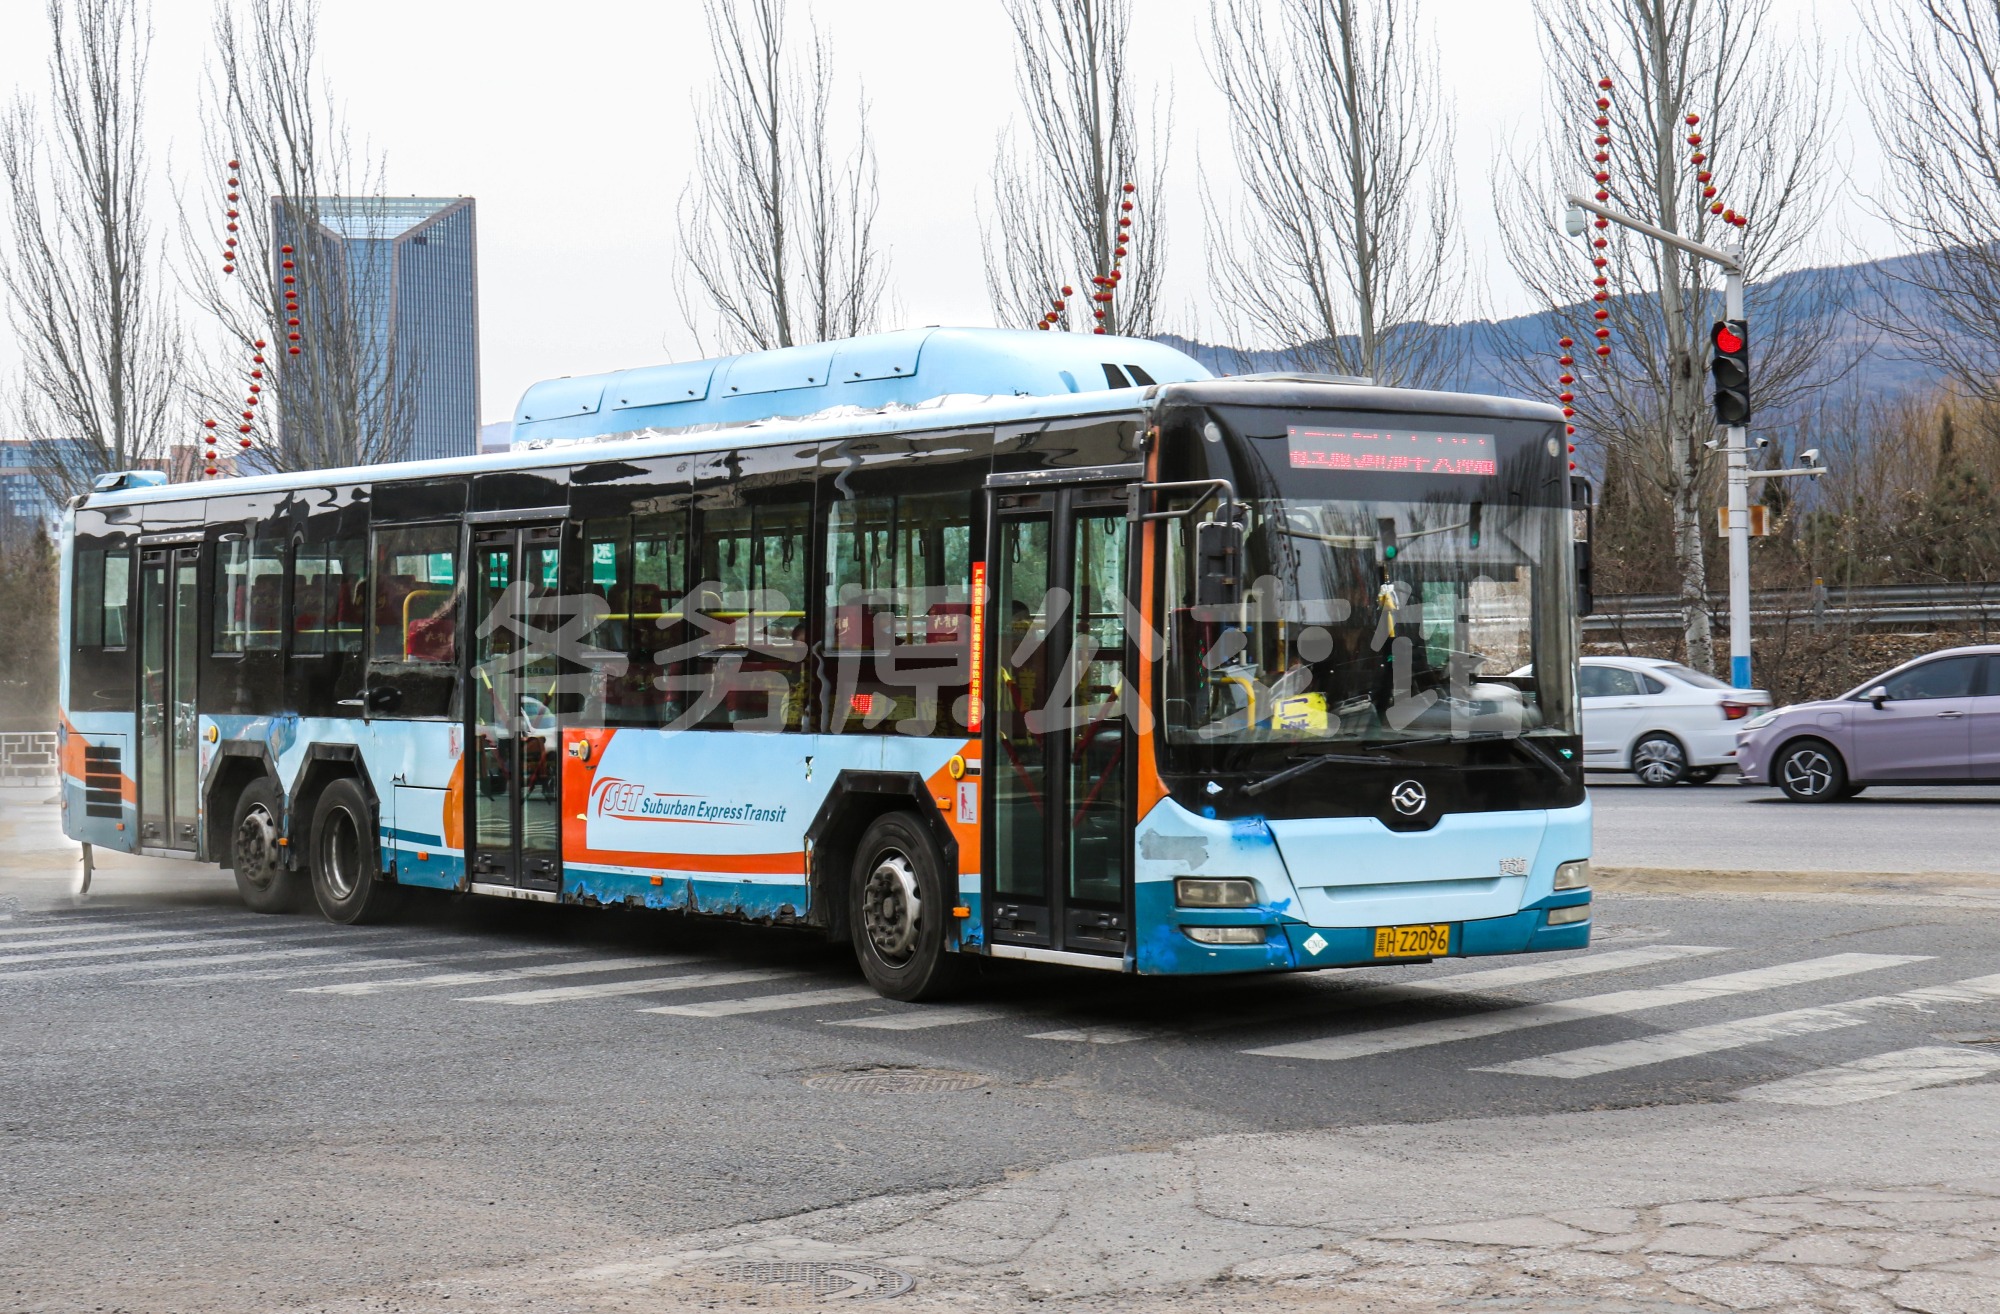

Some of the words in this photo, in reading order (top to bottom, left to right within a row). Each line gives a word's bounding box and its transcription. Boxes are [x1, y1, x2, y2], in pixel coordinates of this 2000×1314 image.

[642, 797, 696, 816] Suburban
[697, 801, 743, 821] Express
[744, 803, 787, 823] Transit
[1307, 939, 1325, 949] CNG
